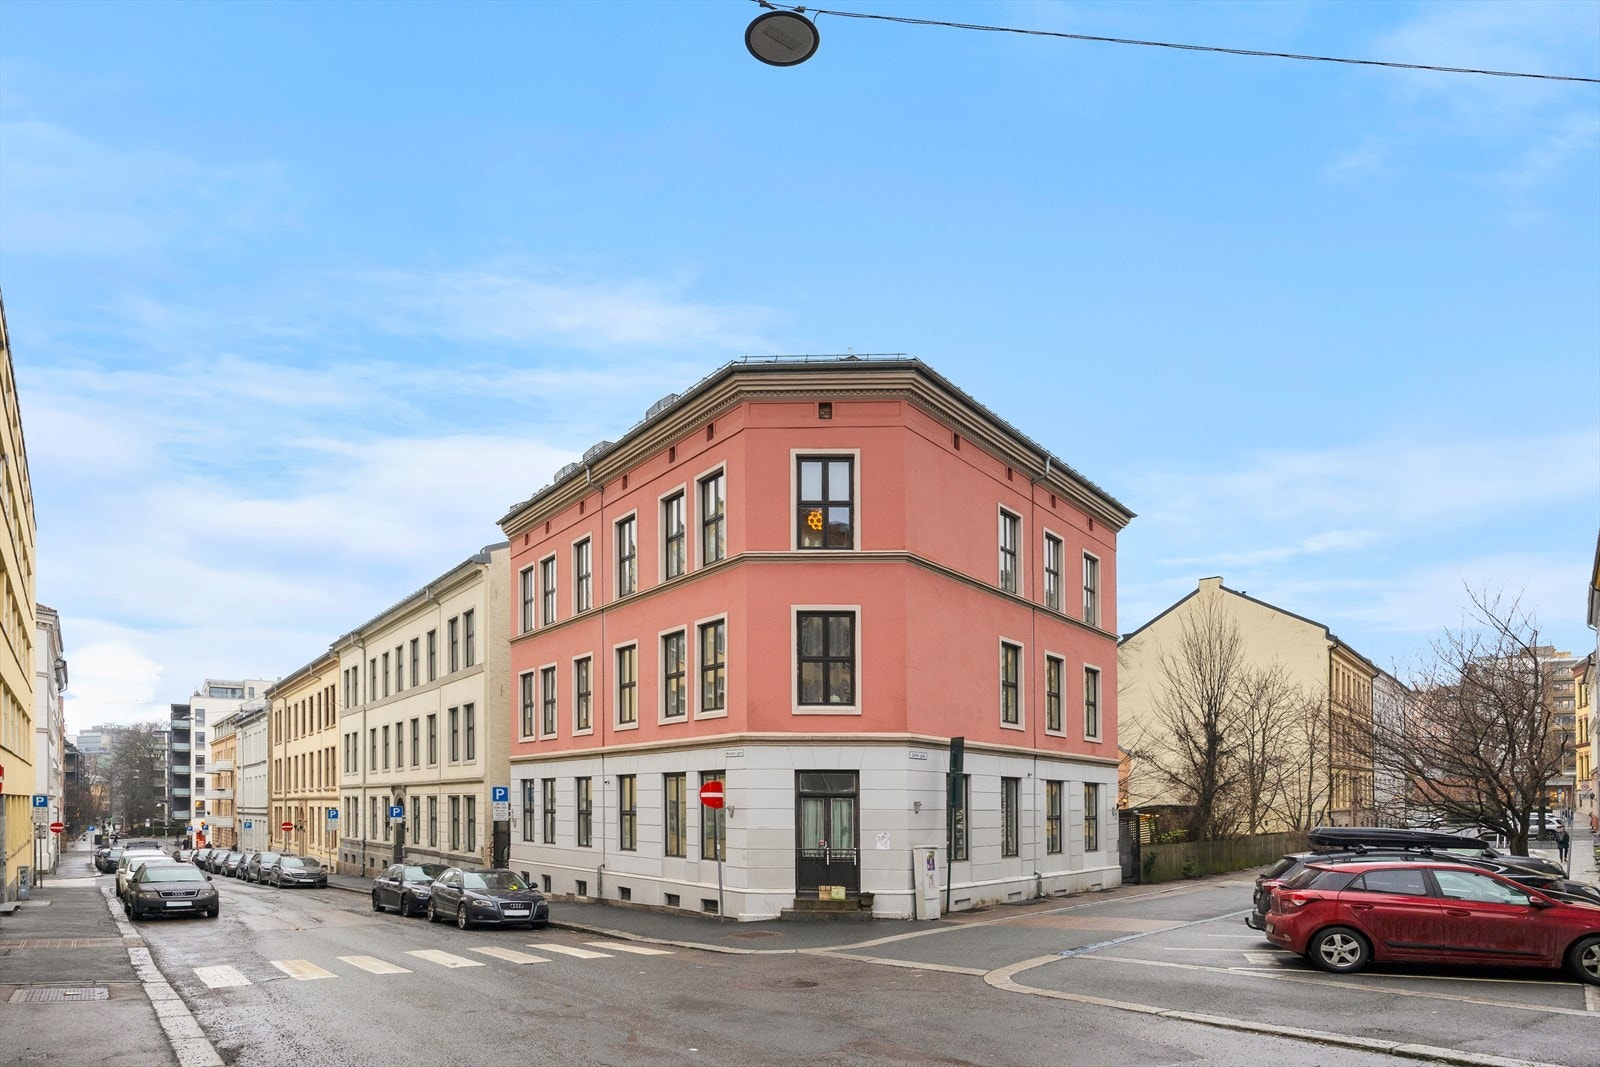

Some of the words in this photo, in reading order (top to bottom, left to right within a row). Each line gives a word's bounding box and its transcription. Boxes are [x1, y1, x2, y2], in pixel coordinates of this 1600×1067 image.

[496, 789, 504, 799] P
[36, 797, 44, 806] P
[393, 808, 400, 816] P
